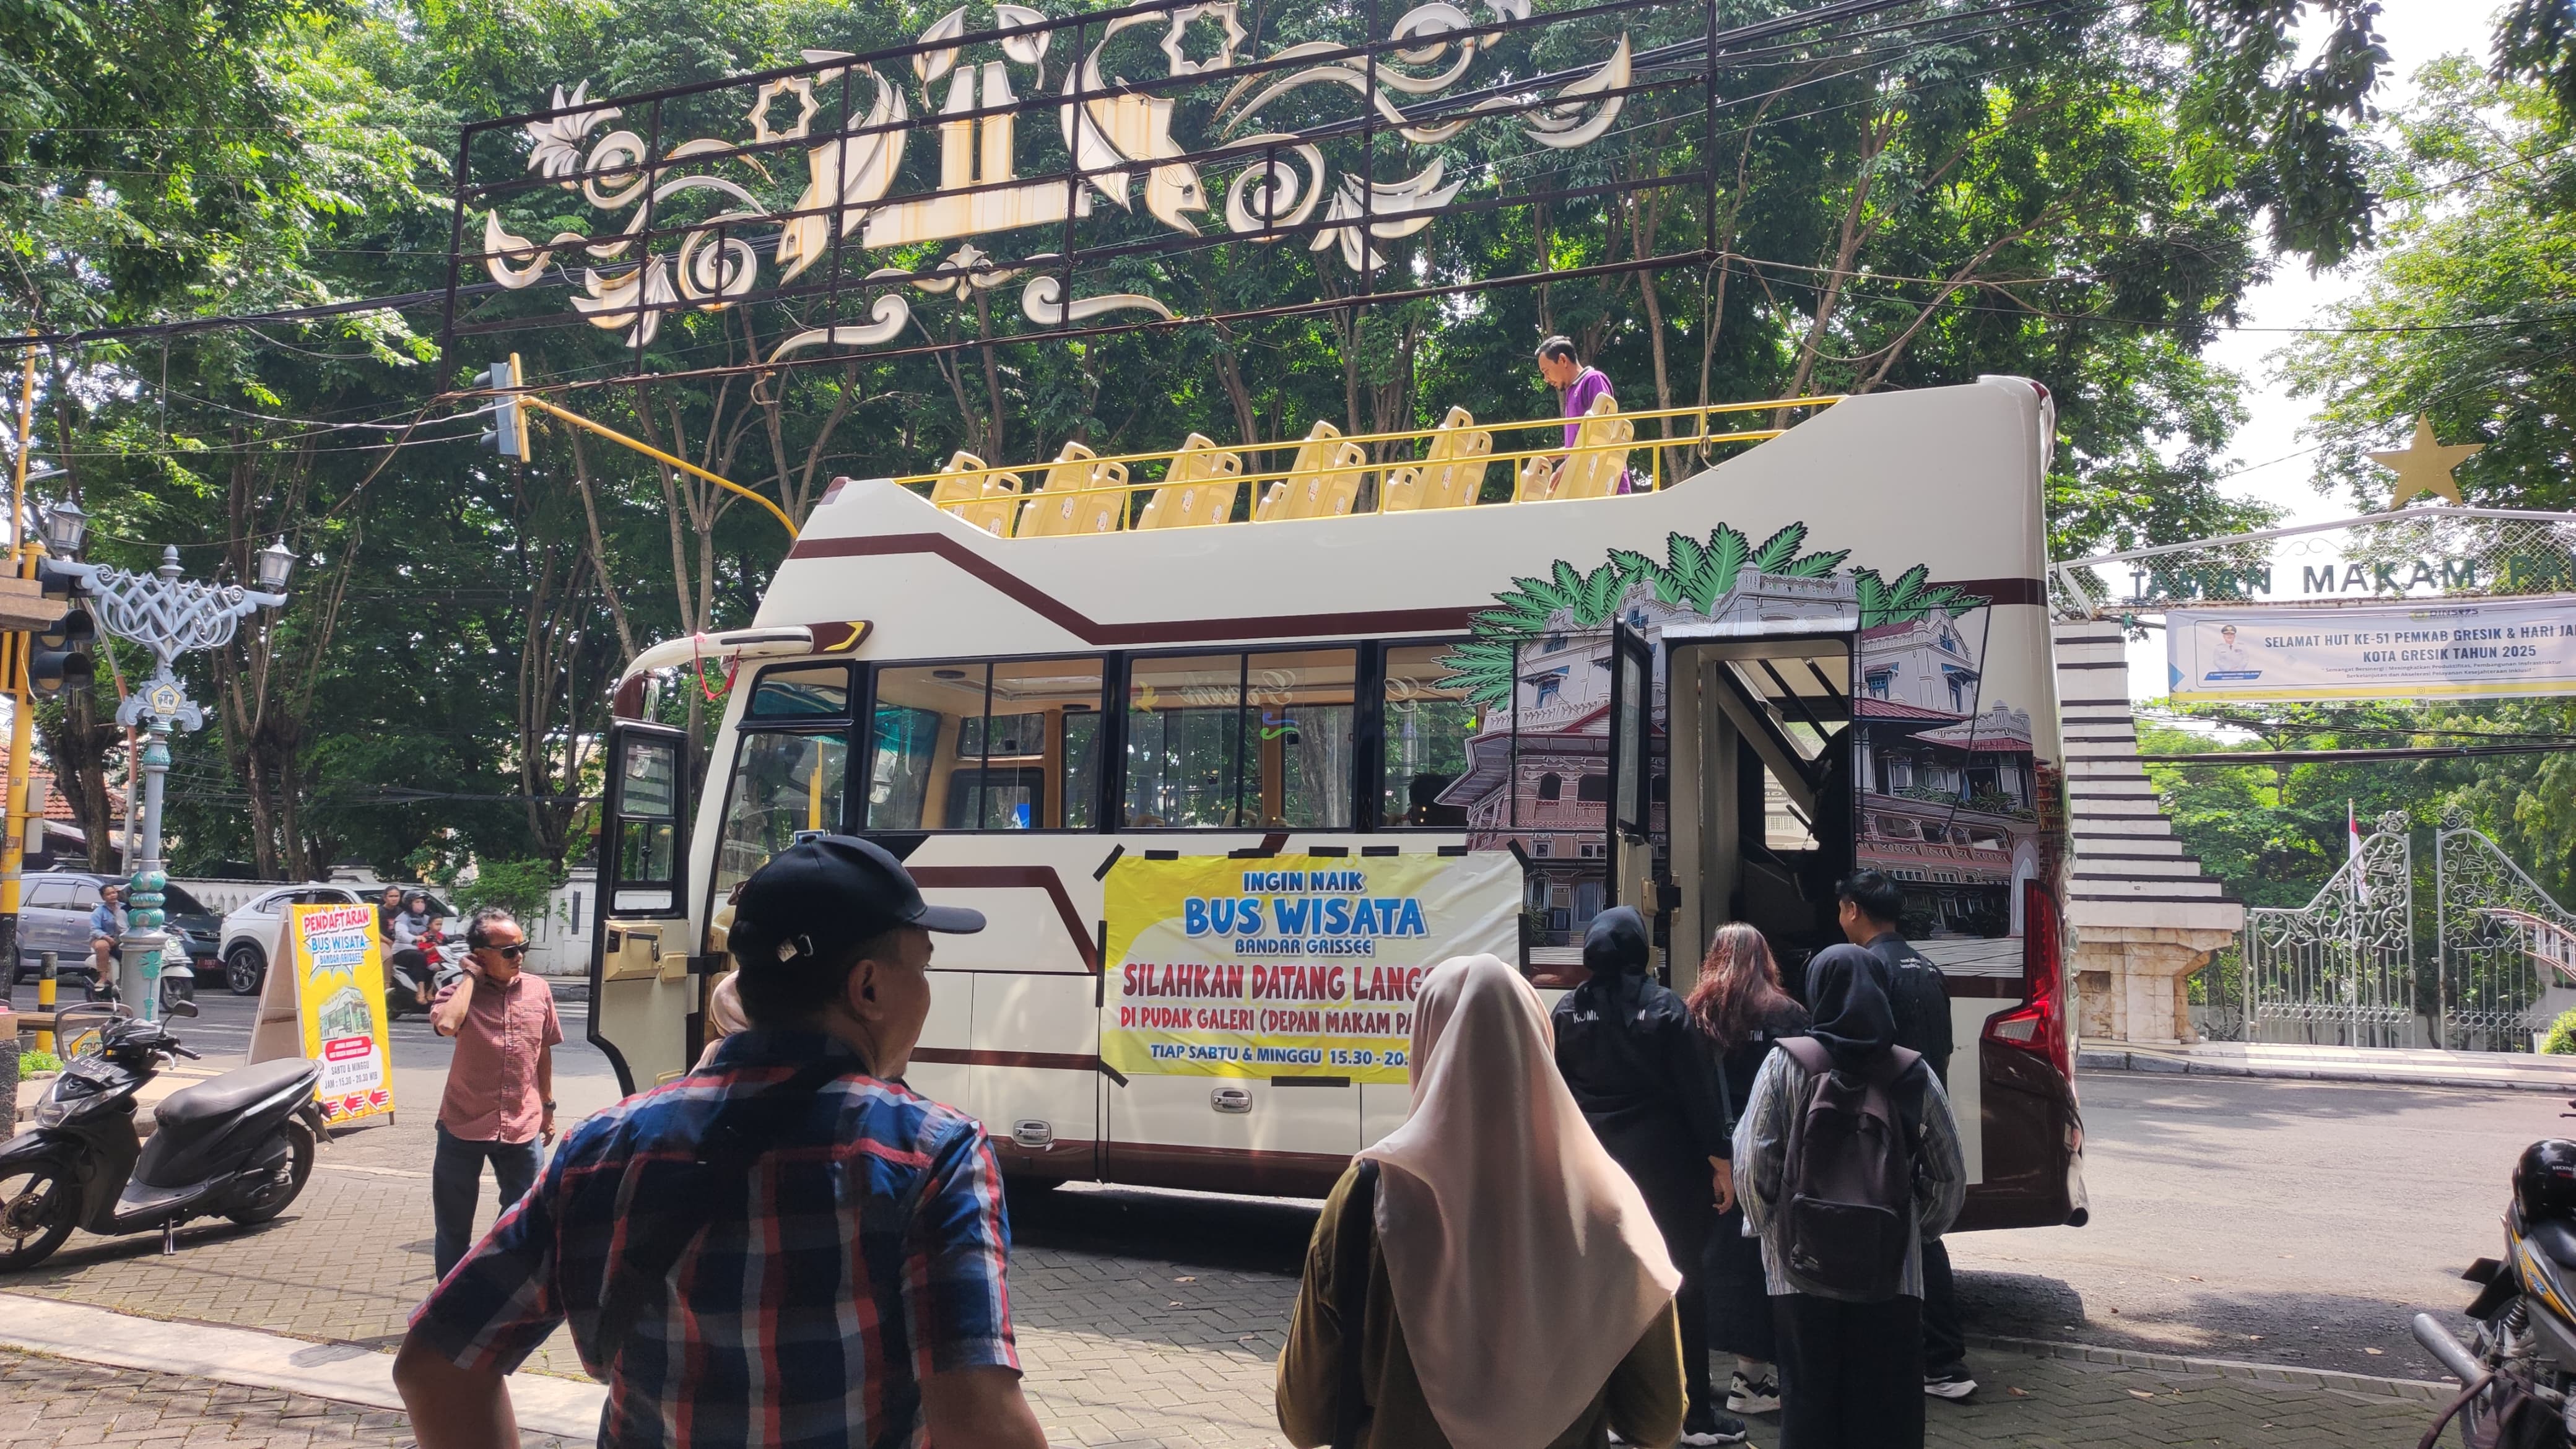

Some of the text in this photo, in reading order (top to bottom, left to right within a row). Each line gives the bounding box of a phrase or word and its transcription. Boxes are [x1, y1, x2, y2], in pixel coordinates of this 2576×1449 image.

[2303, 559, 2476, 593] MAKAM
[2509, 554, 2576, 587] PA
[2265, 624, 2576, 648] SELAMAT HUT KE-51 PEMKAB GRESIK & HARI JA
[2363, 645, 2537, 663] KOTA GRESIK TAHUN 2025
[1243, 872, 1363, 892] INGIN NAIK
[304, 908, 370, 933] PENDAFTARAN
[1185, 898, 1427, 936] BUS WISATA
[311, 935, 366, 951] BUS WISATA
[1235, 939, 1373, 956] BANDAR GRISSEE
[320, 952, 362, 965] BANDAR GRISSEE
[1123, 963, 1435, 1001] SILAHKAN DATANG LANG
[1121, 1006, 1136, 1029] DI
[1141, 1007, 1193, 1030] PUDAK
[1196, 1008, 1255, 1031] GALERI
[1260, 1008, 1320, 1033] (DEPAN
[1325, 1011, 1391, 1035] MAKAM
[1572, 1009, 1599, 1024] KOMI
[1748, 1030, 1764, 1042] TIM
[1151, 1044, 1185, 1059] TIAP
[1188, 1045, 1238, 1061] SABTU
[1243, 1046, 1253, 1061] &
[1256, 1048, 1322, 1064] MINGGU
[1329, 1050, 1373, 1065] 15.30
[331, 1064, 346, 1075] SABTU
[352, 1061, 370, 1071] MINGGU
[324, 1079, 335, 1089] JAM
[339, 1076, 352, 1086] 15.30
[370, 1071, 378, 1081] WIB
